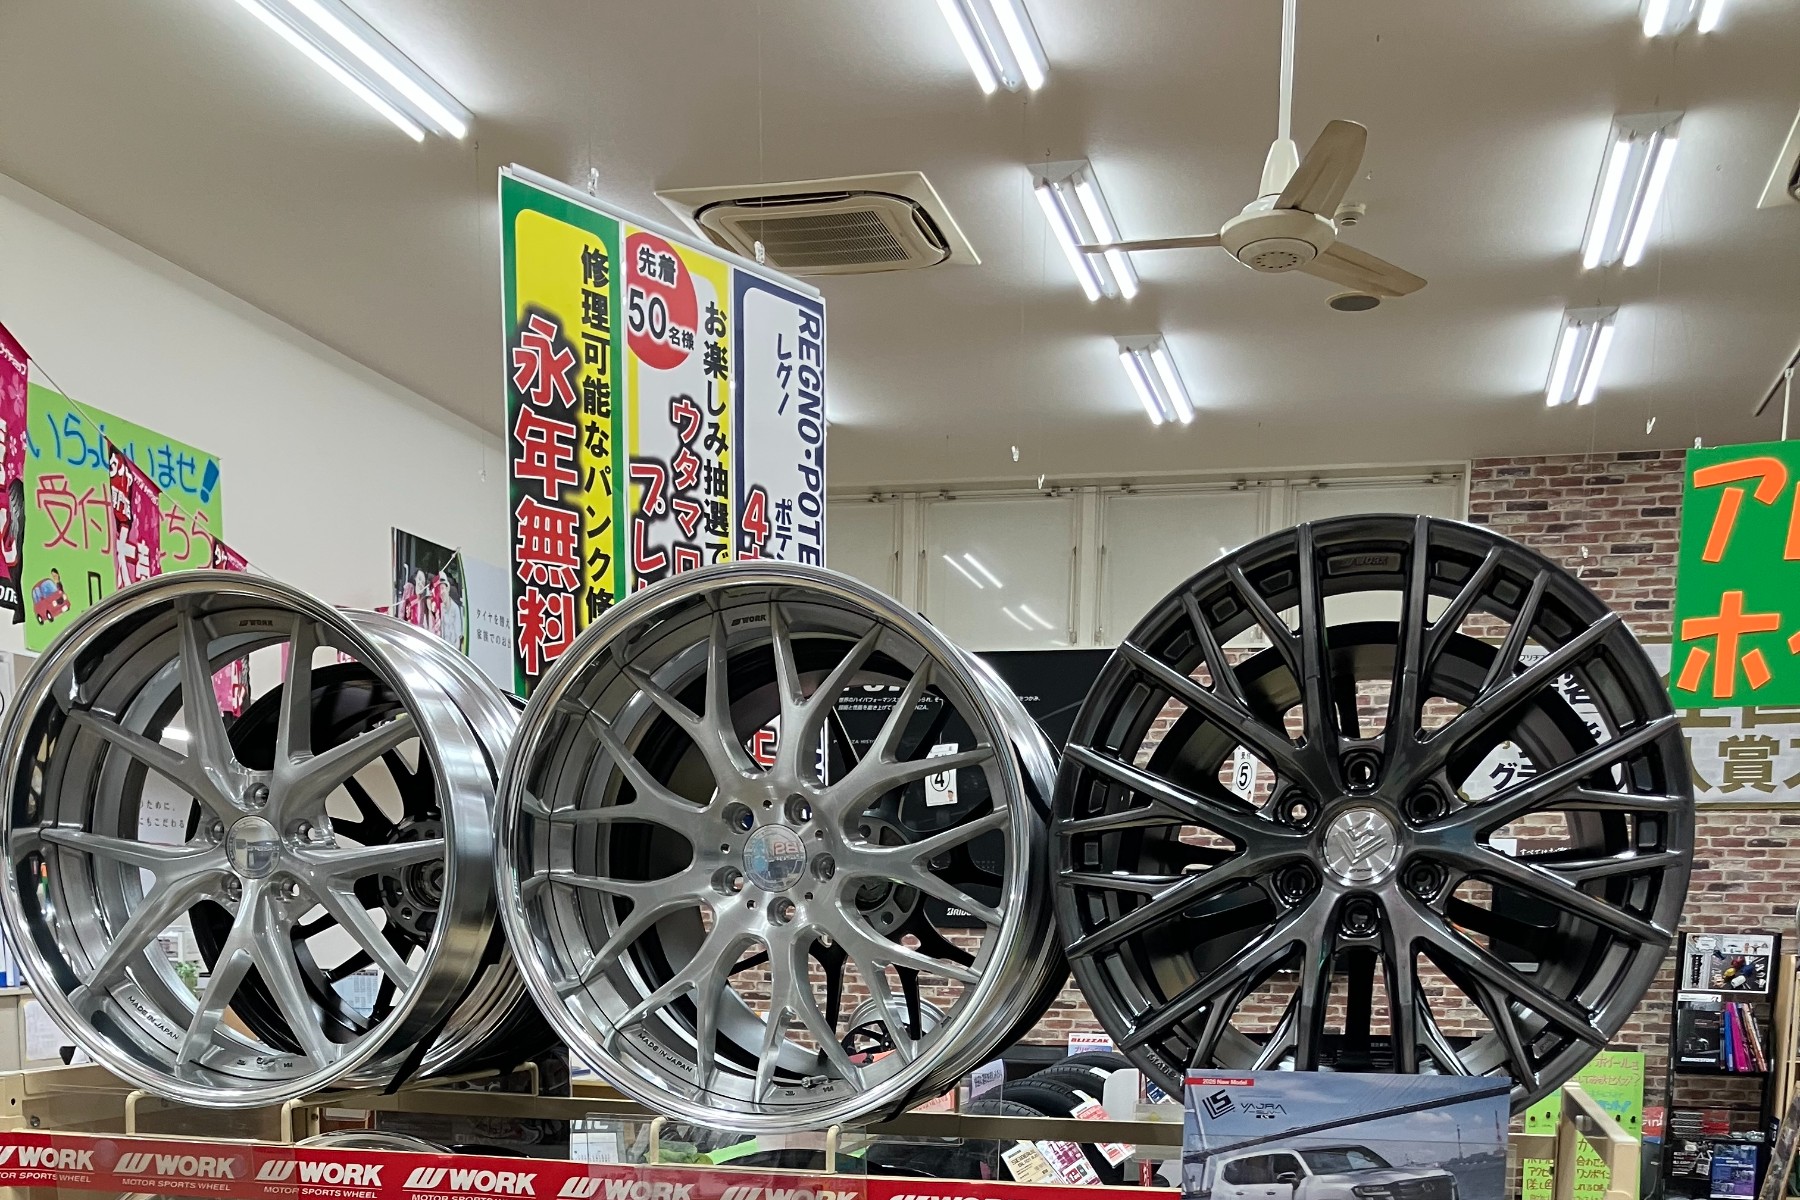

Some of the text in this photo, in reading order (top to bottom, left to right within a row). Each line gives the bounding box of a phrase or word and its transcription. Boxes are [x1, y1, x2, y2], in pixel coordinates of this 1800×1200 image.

[638, 247, 676, 285] 先着
[776, 333, 793, 416] レグノ
[703, 301, 729, 564] お楽しみ抽選で
[513, 312, 581, 676] 永年無料
[672, 399, 701, 575] ウタマロ
[37, 474, 213, 569] 受付ちら
[1693, 456, 1800, 562] ア
[629, 463, 667, 591] プレ
[742, 614, 766, 623] WORK
[1676, 590, 1800, 698] ホ
[934, 772, 945, 788] 4
[1238, 765, 1249, 787] 5
[154, 1020, 180, 1040] JAPAN
[1070, 1037, 1110, 1045] BLIZZAK
[637, 1032, 659, 1052] MADE
[666, 1054, 693, 1073] JAPAN
[18, 1146, 95, 1171] WORK
[155, 1154, 236, 1179] WORK
[19, 1172, 57, 1181] SPORTS
[59, 1174, 92, 1183] WHEEL
[122, 1178, 232, 1191] MOTOR SPORTS WHEEL
[299, 1161, 385, 1187] WORK
[449, 1169, 538, 1196] WORK
[263, 1186, 378, 1199] MOTOR SPORTS WHEEL
